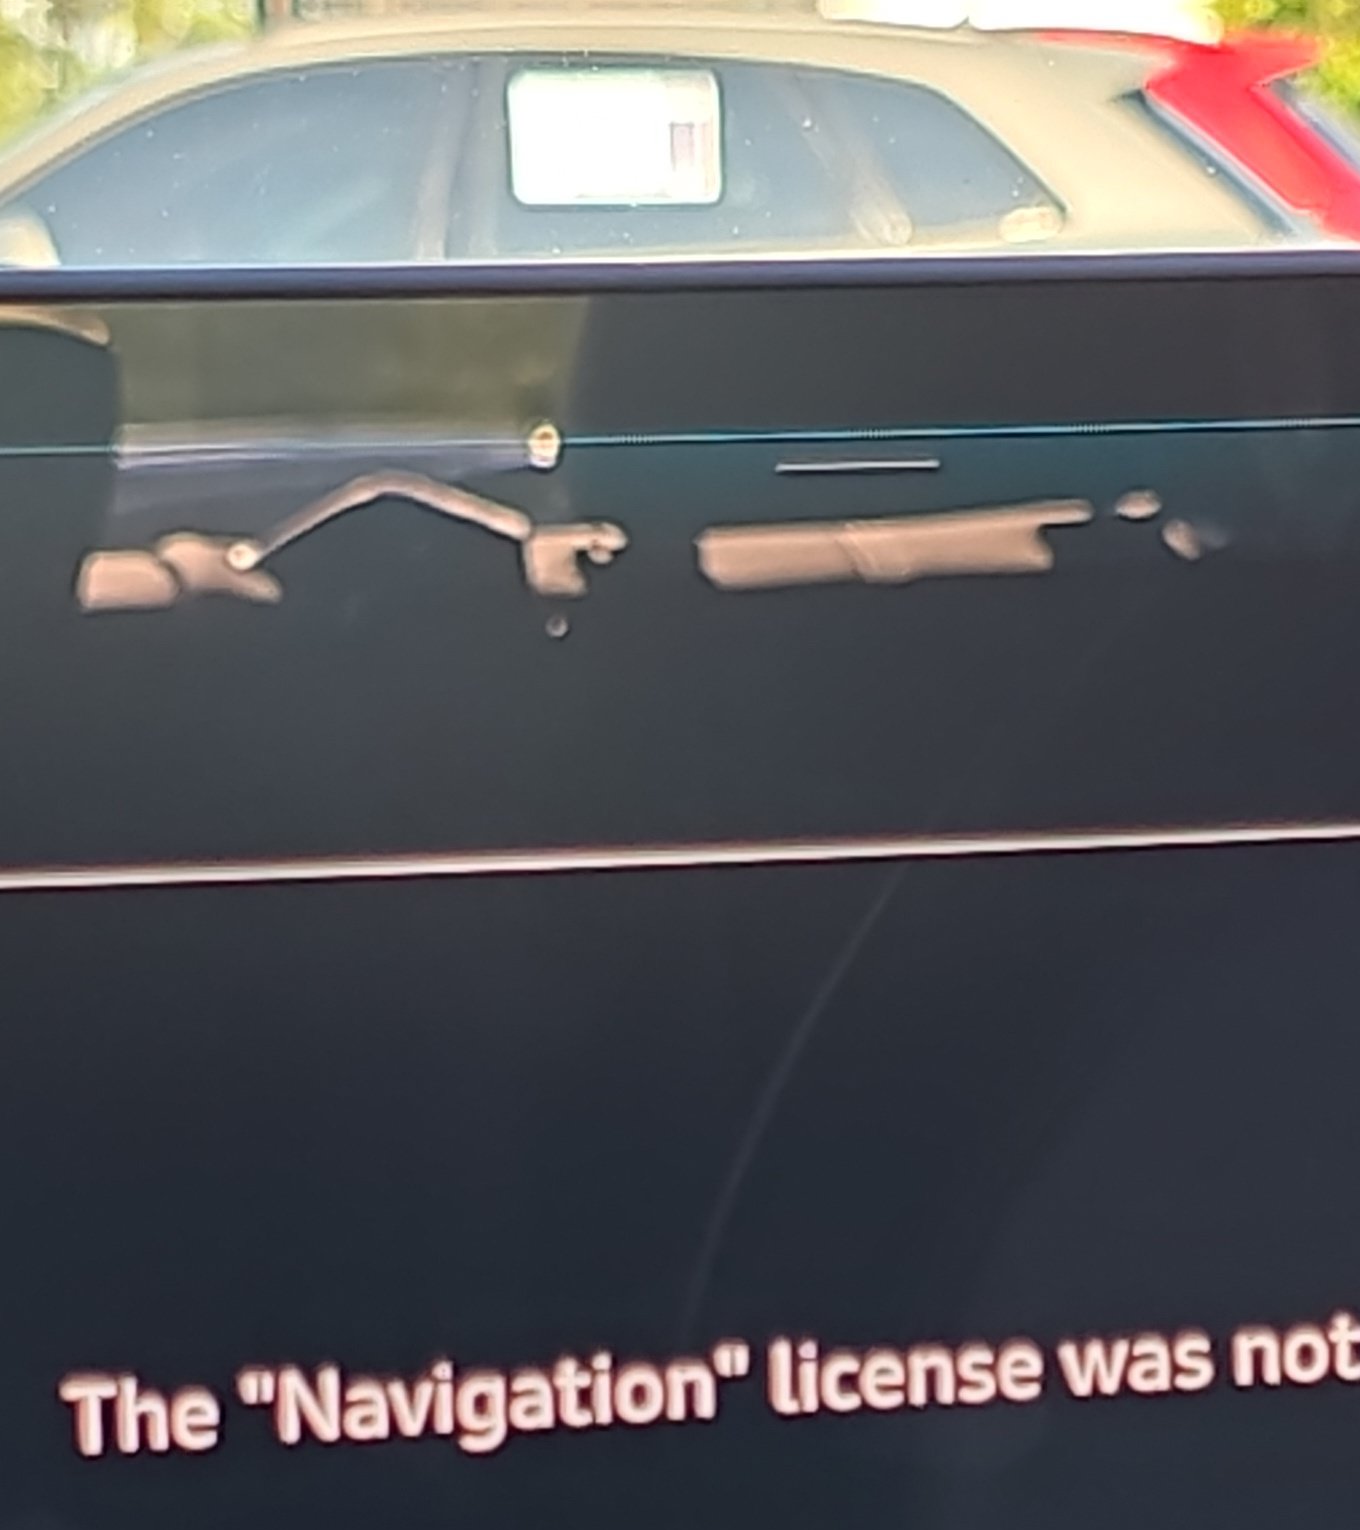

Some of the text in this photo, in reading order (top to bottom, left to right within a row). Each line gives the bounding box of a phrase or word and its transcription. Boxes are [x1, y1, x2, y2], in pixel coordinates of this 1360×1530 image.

[59, 1373, 221, 1457] The
[237, 1340, 751, 1454] "Navigation"
[767, 1337, 1044, 1416] license
[1056, 1330, 1215, 1398] was
